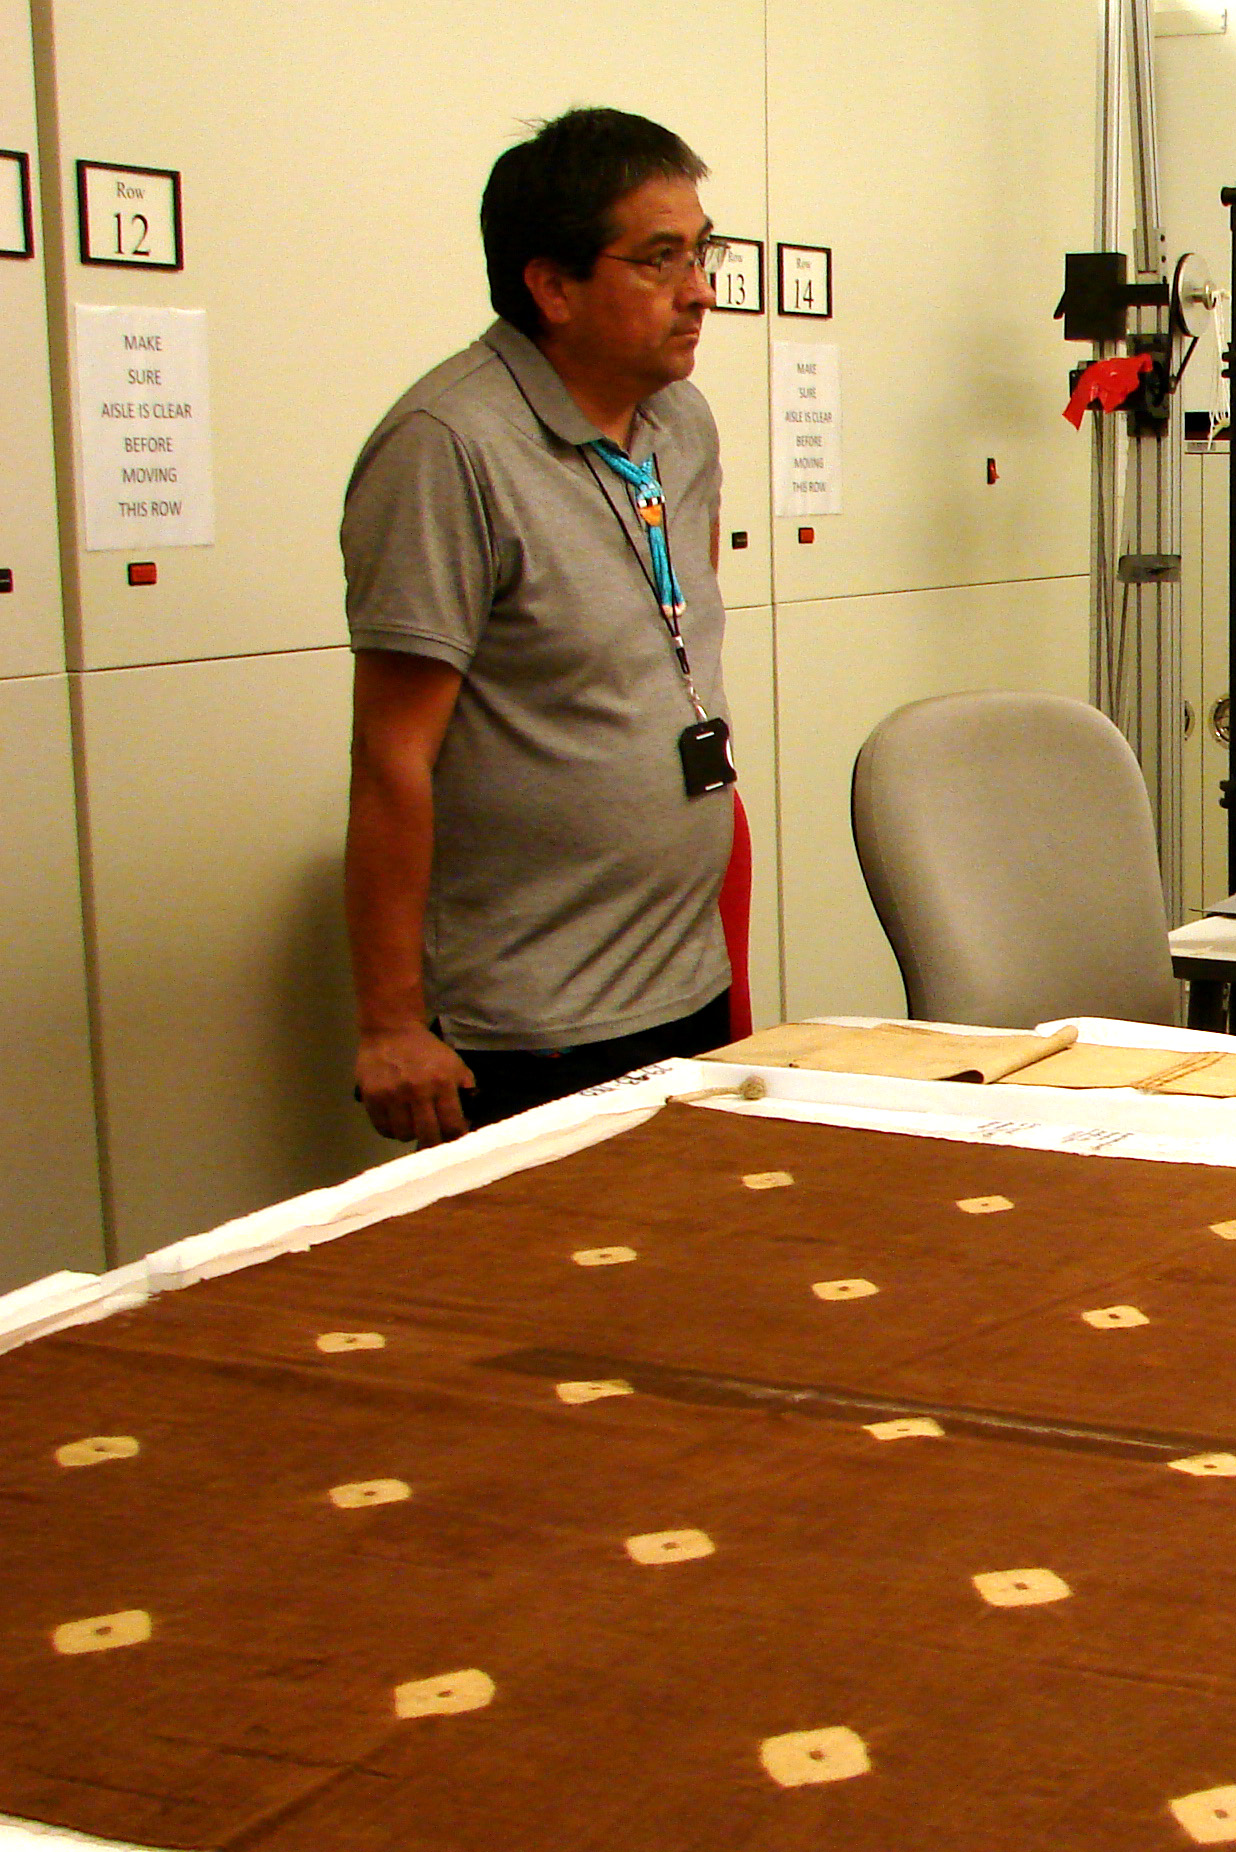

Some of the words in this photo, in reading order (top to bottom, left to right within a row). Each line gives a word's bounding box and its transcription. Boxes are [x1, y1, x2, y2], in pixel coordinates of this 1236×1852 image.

[116, 181, 145, 199] Row
[113, 212, 151, 256] 12
[726, 273, 746, 305] 13
[794, 279, 815, 309] 14
[124, 335, 163, 351] MAKE
[797, 363, 817, 375] MAKE
[128, 369, 162, 386] SURE
[799, 387, 817, 399] SURE
[101, 402, 134, 419] AISLE
[139, 403, 150, 419] IS
[153, 403, 193, 419] CLEAR
[785, 411, 803, 423] AISLE
[804, 411, 811, 422] IS
[812, 411, 833, 423] CLEAR
[124, 437, 173, 453] BEFORE
[796, 435, 822, 447] BEFORE
[794, 457, 824, 469] MOVING
[122, 468, 178, 483] MOVING
[792, 482, 807, 493] THIS
[809, 481, 826, 492] ROW
[118, 502, 148, 518] THIS
[151, 502, 183, 517] ROW
